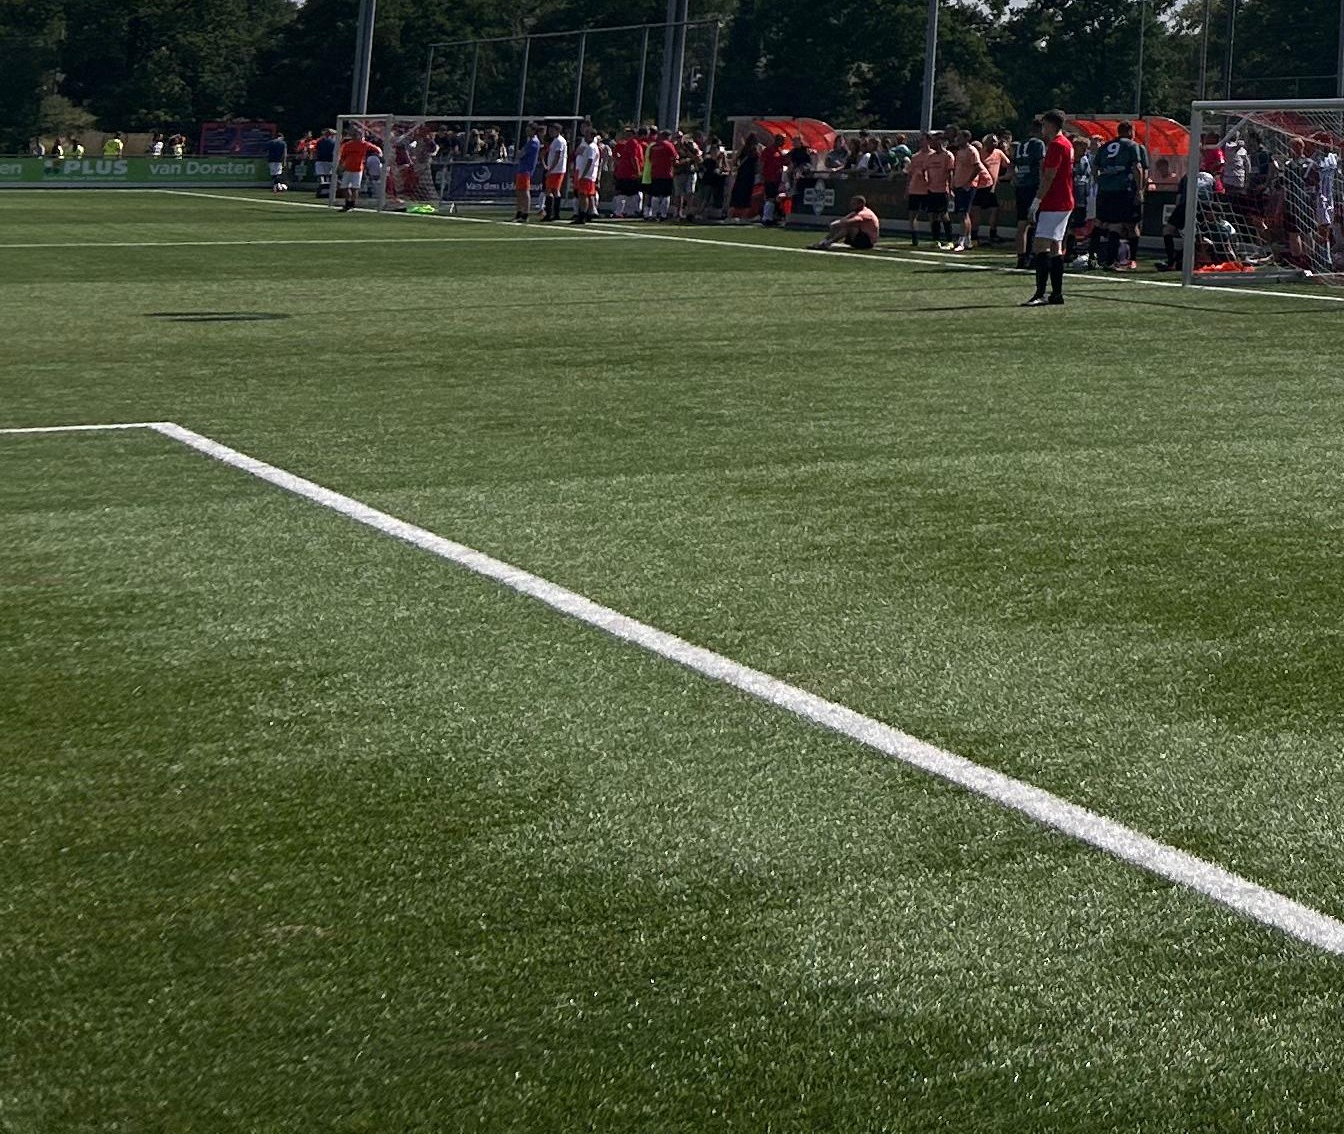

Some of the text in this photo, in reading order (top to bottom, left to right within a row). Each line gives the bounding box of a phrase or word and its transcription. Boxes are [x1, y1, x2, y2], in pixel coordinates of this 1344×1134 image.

[1107, 142, 1121, 158] 9
[64, 160, 128, 175] PLUS
[149, 161, 256, 175] van Dorsten
